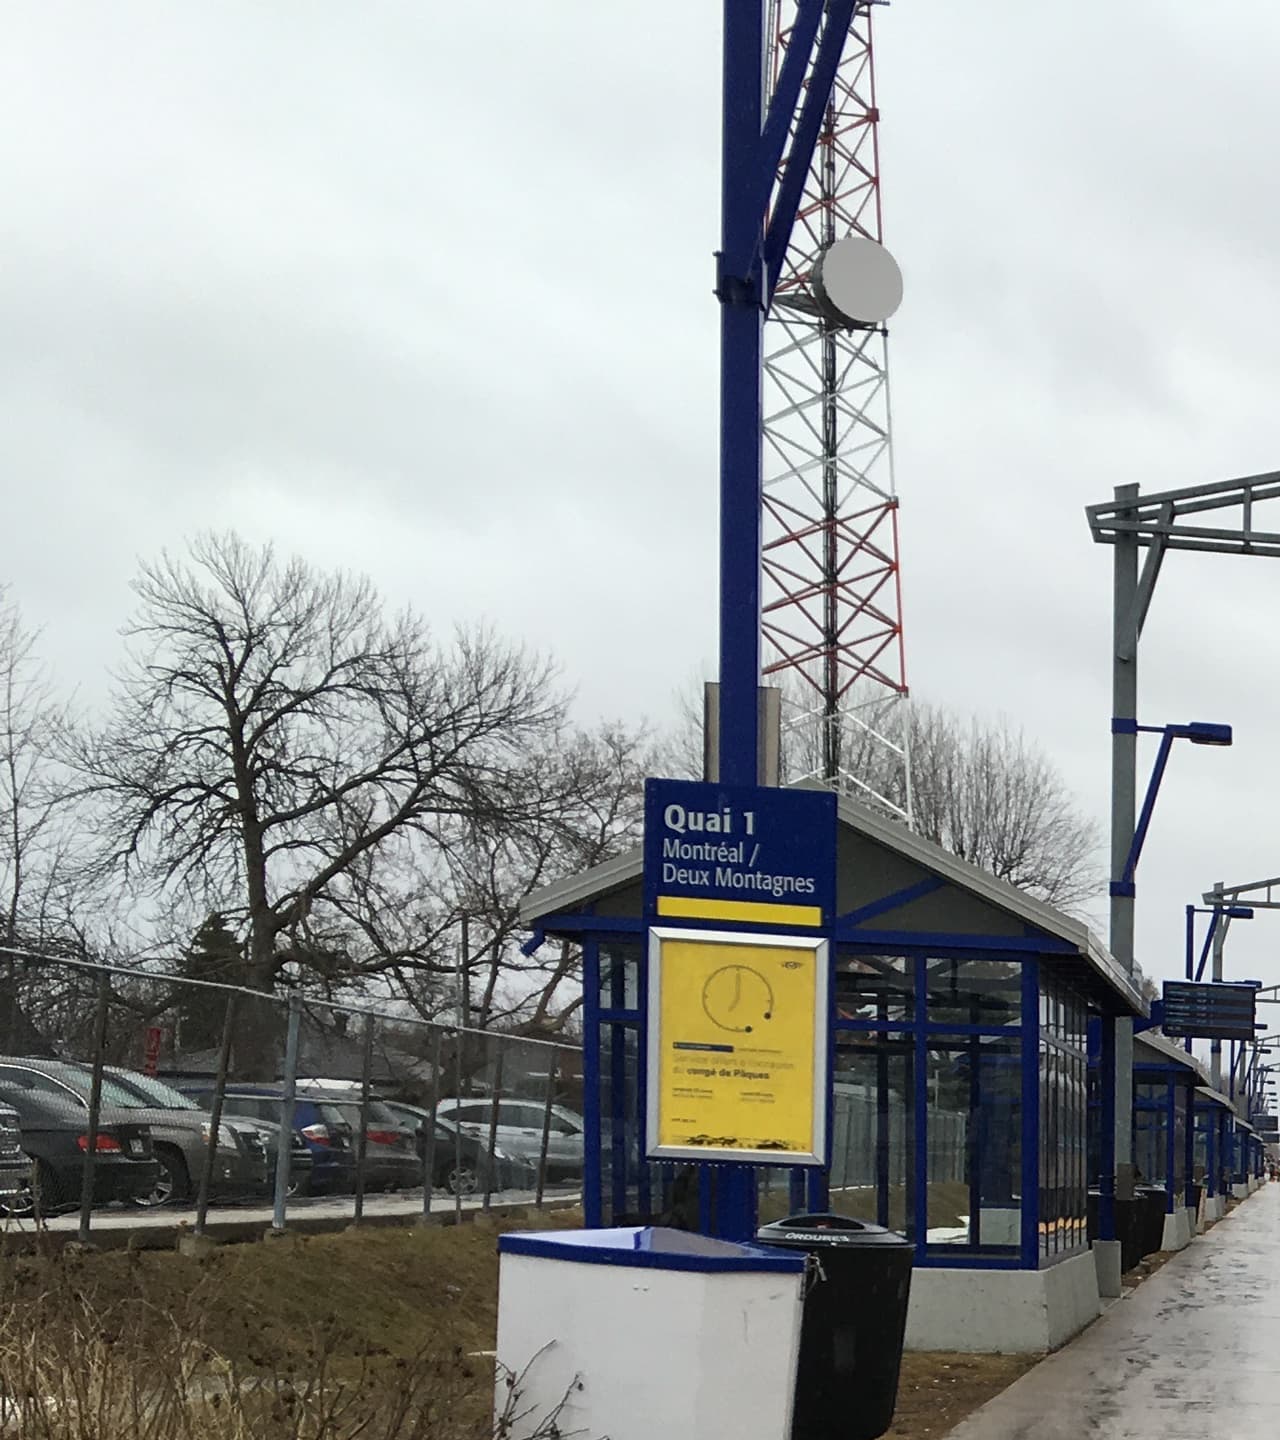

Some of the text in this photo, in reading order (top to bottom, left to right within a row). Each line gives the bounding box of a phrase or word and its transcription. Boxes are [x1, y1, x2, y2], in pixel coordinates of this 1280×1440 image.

[664, 804, 754, 835] Quai 1
[663, 838, 760, 867] Montréal /
[663, 863, 815, 897] Deux Montagnes
